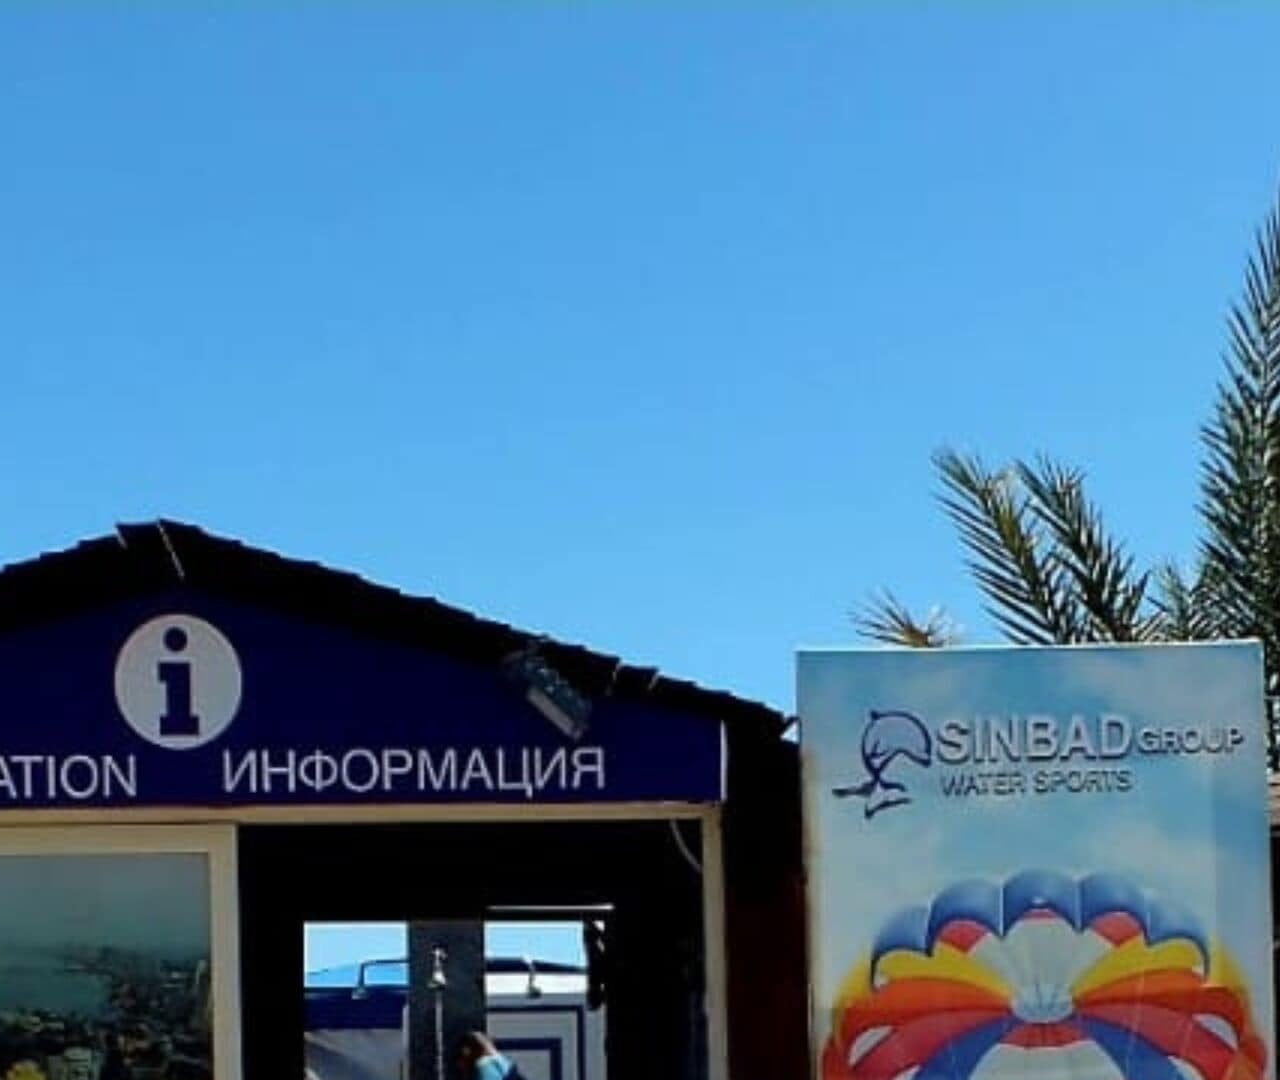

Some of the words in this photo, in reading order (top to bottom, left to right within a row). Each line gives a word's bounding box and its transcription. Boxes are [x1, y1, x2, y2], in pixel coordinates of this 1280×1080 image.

[936, 714, 1132, 766] SINBAD
[1137, 726, 1246, 755] GROUP
[222, 747, 606, 798] ИНФОРМАЦИЯ
[941, 769, 1026, 798] WATER
[1034, 767, 1134, 794] SPORTS
